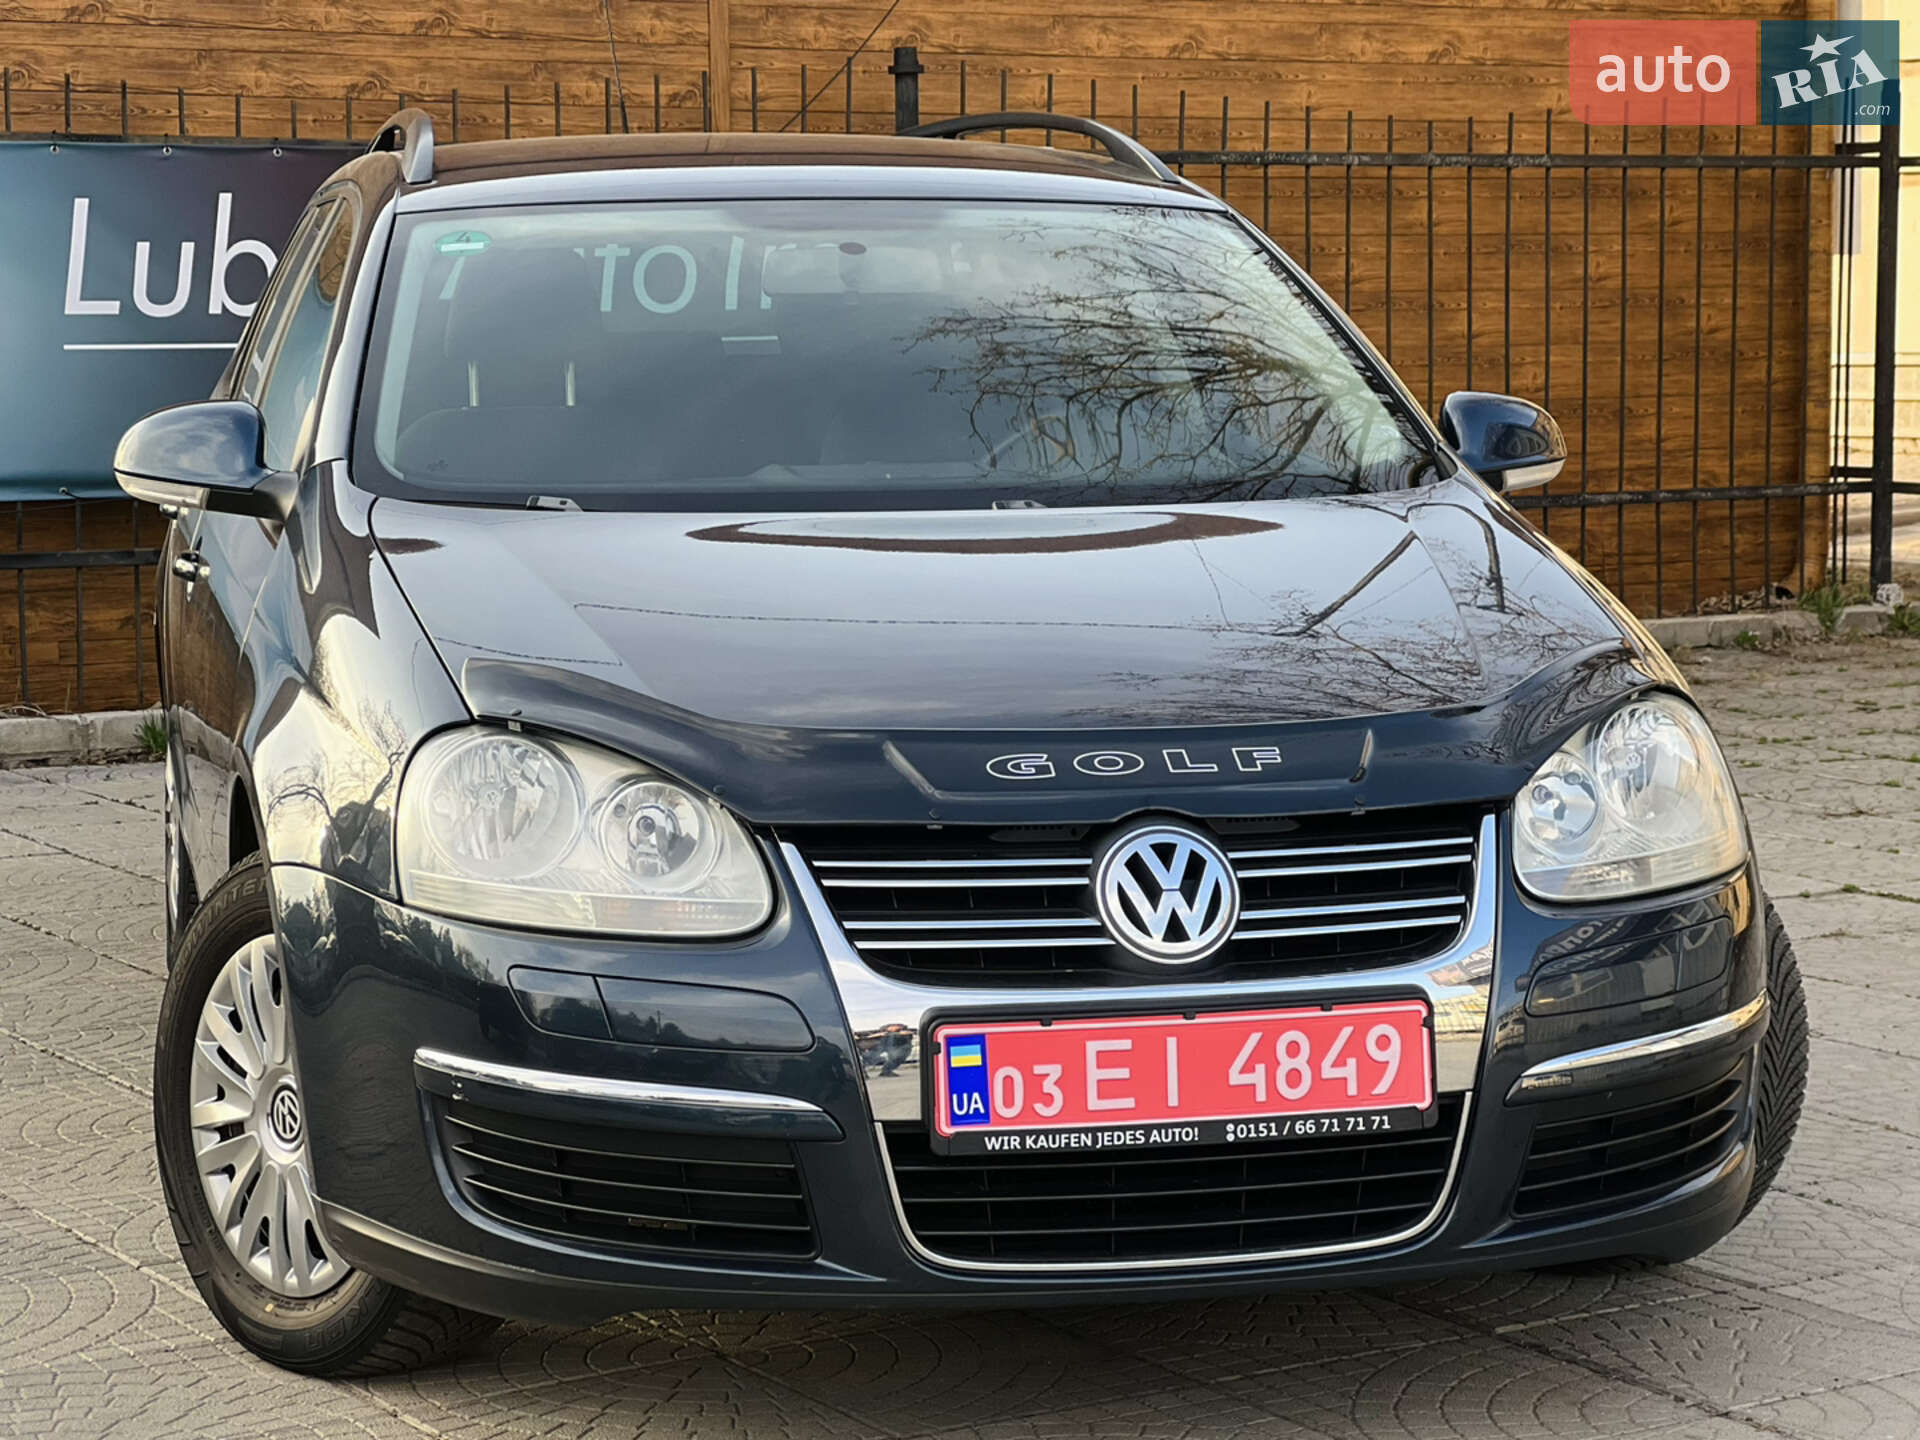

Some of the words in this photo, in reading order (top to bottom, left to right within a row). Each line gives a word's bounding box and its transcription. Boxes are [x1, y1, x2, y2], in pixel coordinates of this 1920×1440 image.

[986, 747, 1282, 779] GOLF
[993, 1064, 1064, 1119] 03
[1228, 1023, 1402, 1104] 4849
[952, 1092, 985, 1116] UA
[984, 1135, 1021, 1150] WIR
[1025, 1132, 1092, 1150] KAUFEN
[1096, 1129, 1145, 1148] JEDES
[1149, 1126, 1200, 1144] AUTO!
[1236, 1122, 1278, 1139] 0151
[1295, 1119, 1316, 1134] 66
[1320, 1118, 1340, 1133] 71
[1345, 1117, 1365, 1131] 71
[1371, 1115, 1391, 1130] 71
